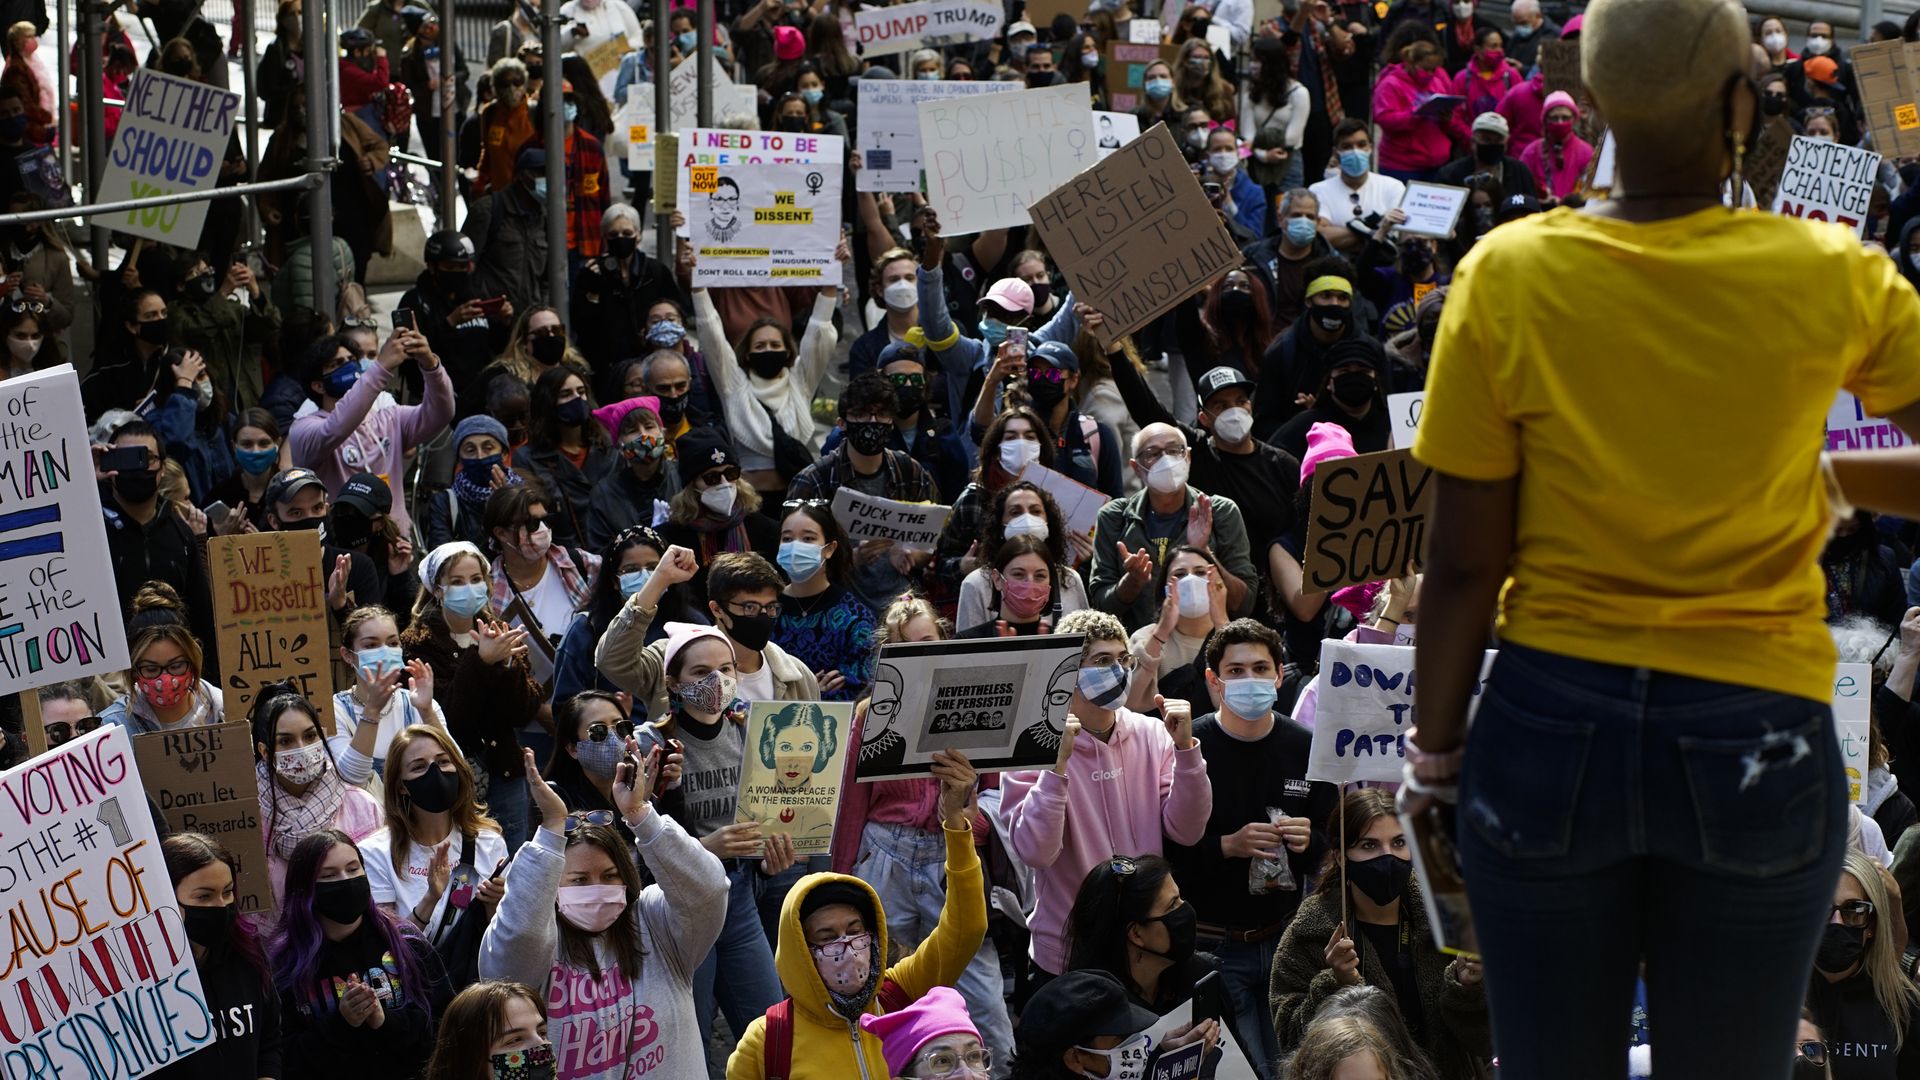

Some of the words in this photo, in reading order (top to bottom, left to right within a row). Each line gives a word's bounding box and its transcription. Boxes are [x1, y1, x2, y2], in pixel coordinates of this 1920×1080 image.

[860, 15, 928, 43] DUMP
[934, 8, 996, 27] TRUMP
[126, 71, 239, 136] NEITHER
[928, 104, 992, 141] BOY
[1003, 92, 1087, 131] THIS
[1900, 110, 1914, 118] OUT
[1901, 118, 1917, 126] NOW
[113, 126, 214, 186] SHOULD
[693, 132, 698, 147] I
[708, 133, 752, 149] NEED
[760, 136, 784, 150] TO
[795, 138, 818, 153] BE
[695, 172, 715, 181] OUT
[1788, 137, 1879, 185] SYSTEMIC
[692, 181, 717, 190] NOW
[775, 195, 795, 205] WE
[1036, 166, 1118, 232] HERE
[1123, 136, 1165, 169] TO
[1782, 168, 1871, 216] CHANGE
[127, 180, 182, 234] YOU
[1067, 169, 1176, 256] LISTEN
[1076, 241, 1129, 297] NOT
[1140, 208, 1189, 245] TO
[770, 269, 788, 277] OUR
[1096, 226, 1234, 336] MANSPLAIN
[1316, 459, 1431, 531] SAV
[848, 499, 893, 521] FUCK
[897, 512, 927, 525] THE
[848, 519, 938, 544] PATRIARCHY
[238, 546, 274, 575] WE
[25, 588, 86, 620] the
[229, 566, 322, 615] Dissent
[238, 630, 281, 672] ALL
[934, 699, 956, 711] SHE
[956, 696, 1013, 710] PERSISTED
[937, 682, 1015, 698] NEVERTHELESS,
[162, 728, 223, 756] RISE
[1, 733, 127, 826] VOTING
[213, 781, 238, 802] let
[747, 786, 754, 794] A
[755, 786, 797, 795] WOMAN'S
[797, 787, 826, 796] PLACE
[827, 787, 836, 795] IS
[750, 795, 760, 804] IN
[762, 796, 778, 805] THE
[779, 796, 833, 805] RESISTANCE
[8, 820, 77, 883] THE
[73, 795, 134, 853] #1
[183, 810, 257, 836] Bastards
[791, 839, 822, 848] EOPLE
[106, 839, 148, 919] OF
[0, 904, 187, 1045] UNWANTED
[3, 967, 213, 1080] PRESIDENCIES
[1172, 1063, 1183, 1079] We
